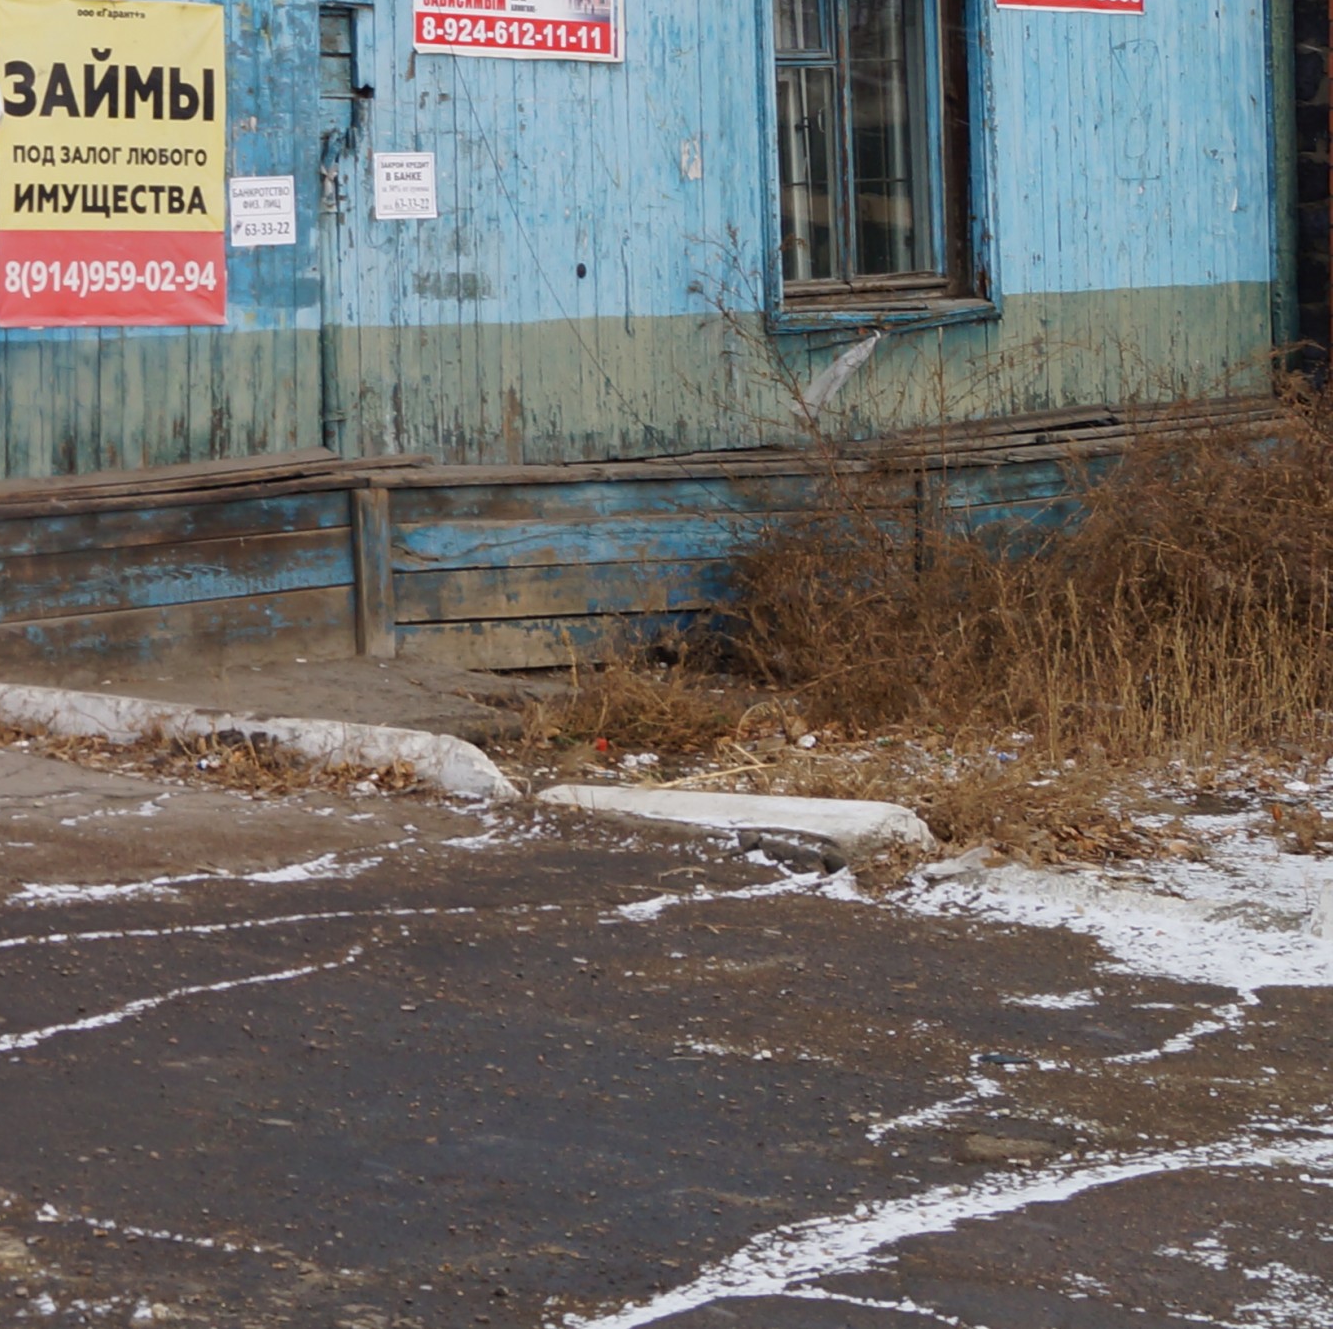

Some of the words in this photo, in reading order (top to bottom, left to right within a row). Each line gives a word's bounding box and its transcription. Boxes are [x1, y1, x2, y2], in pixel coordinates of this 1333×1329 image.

[96, 8, 146, 20] «Гарант+»
[422, 17, 602, 50] 8-924-612-11-11
[4, 47, 215, 122] ЗАЙМЫ
[13, 145, 55, 167] ПОД
[60, 146, 123, 166] ЗАЛОГ
[126, 147, 208, 167] ЛЮБОГО
[386, 172, 391, 181] В
[394, 172, 422, 181] БАНКЕ
[14, 183, 208, 219] ИМУЩЕСТВА
[232, 187, 290, 198] БАНКРОТСТВО
[263, 199, 281, 209] ЛИЦ
[245, 221, 290, 236] 63-33-22
[5, 260, 217, 298] 8(914)959-02-94
